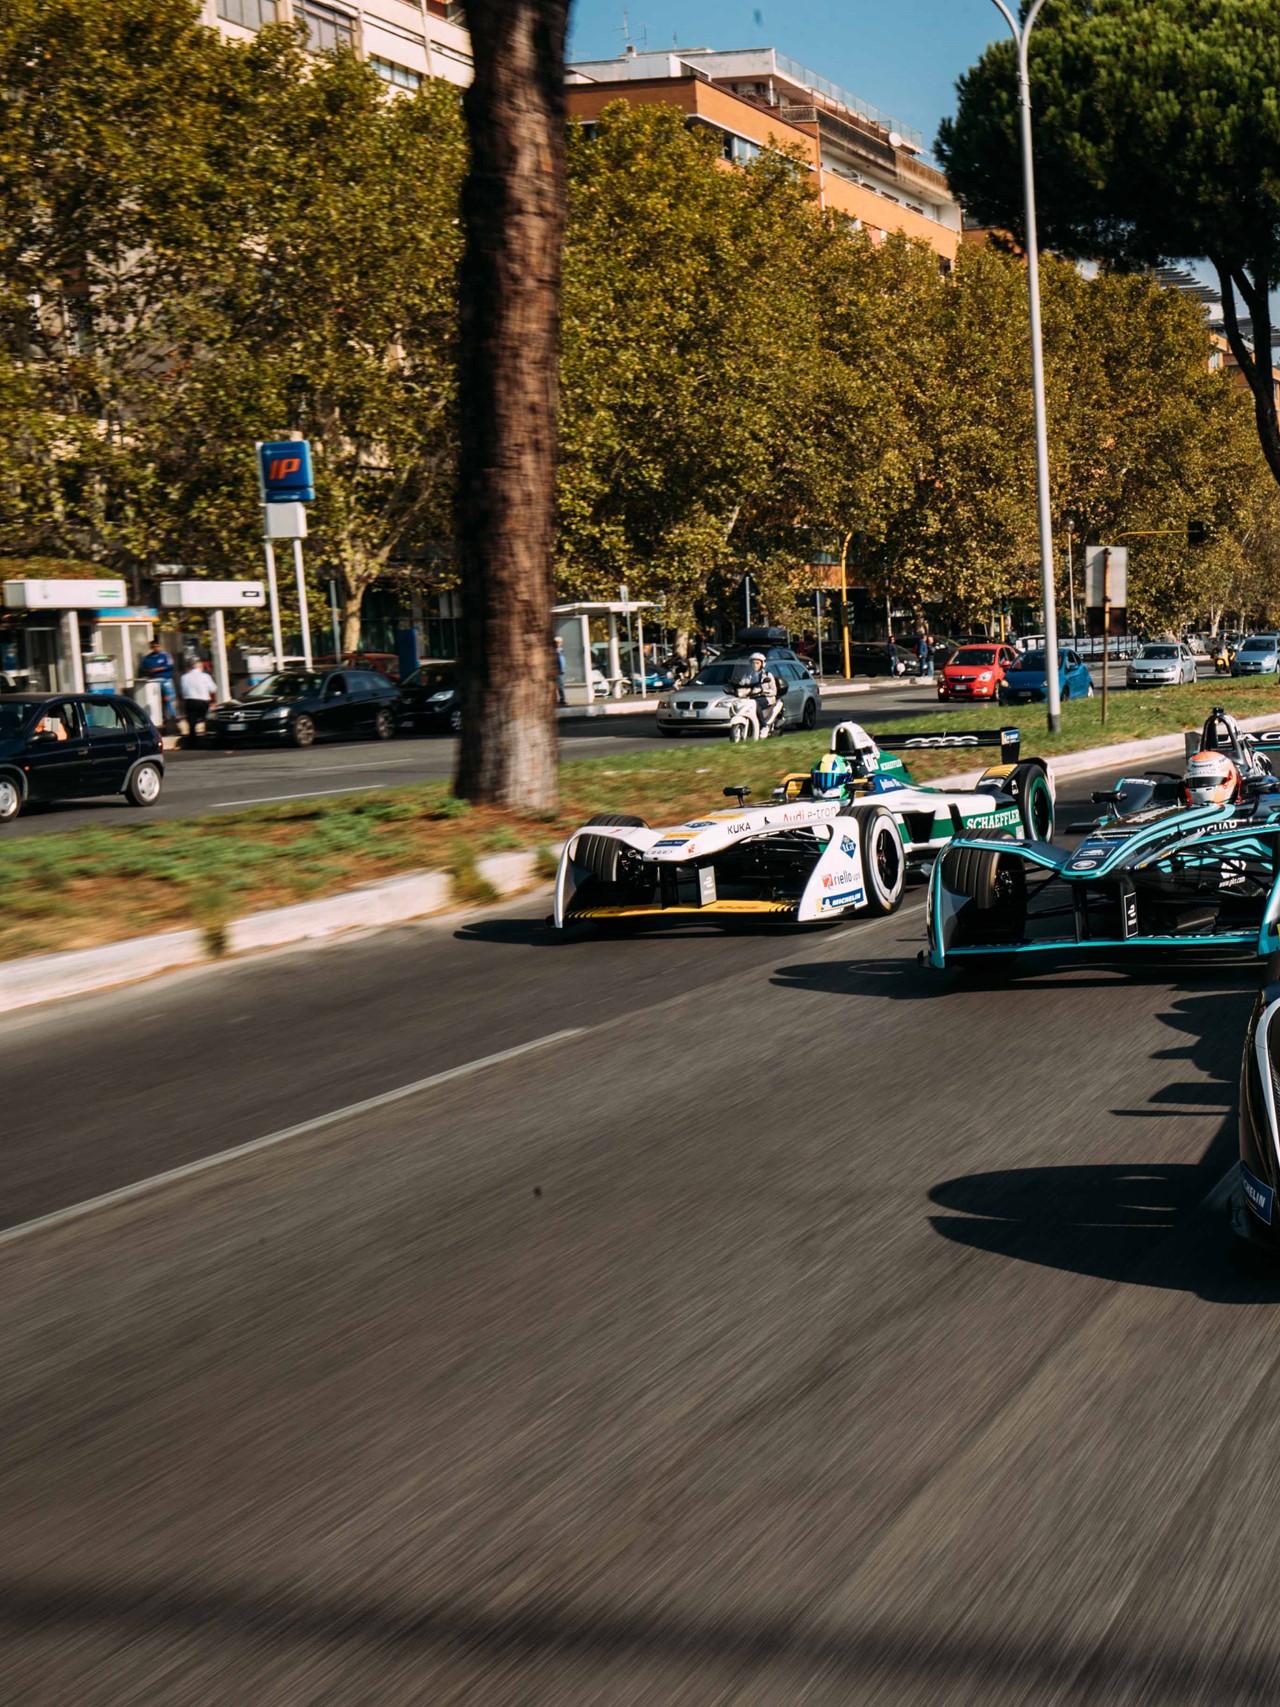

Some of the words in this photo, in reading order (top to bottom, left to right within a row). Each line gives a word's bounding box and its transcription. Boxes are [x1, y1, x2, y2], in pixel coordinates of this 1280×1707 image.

[966, 808, 1021, 830] SCHAEFFLER
[727, 821, 752, 835] KUKA
[833, 869, 853, 886] riello
[832, 892, 862, 906] MICHELIN
